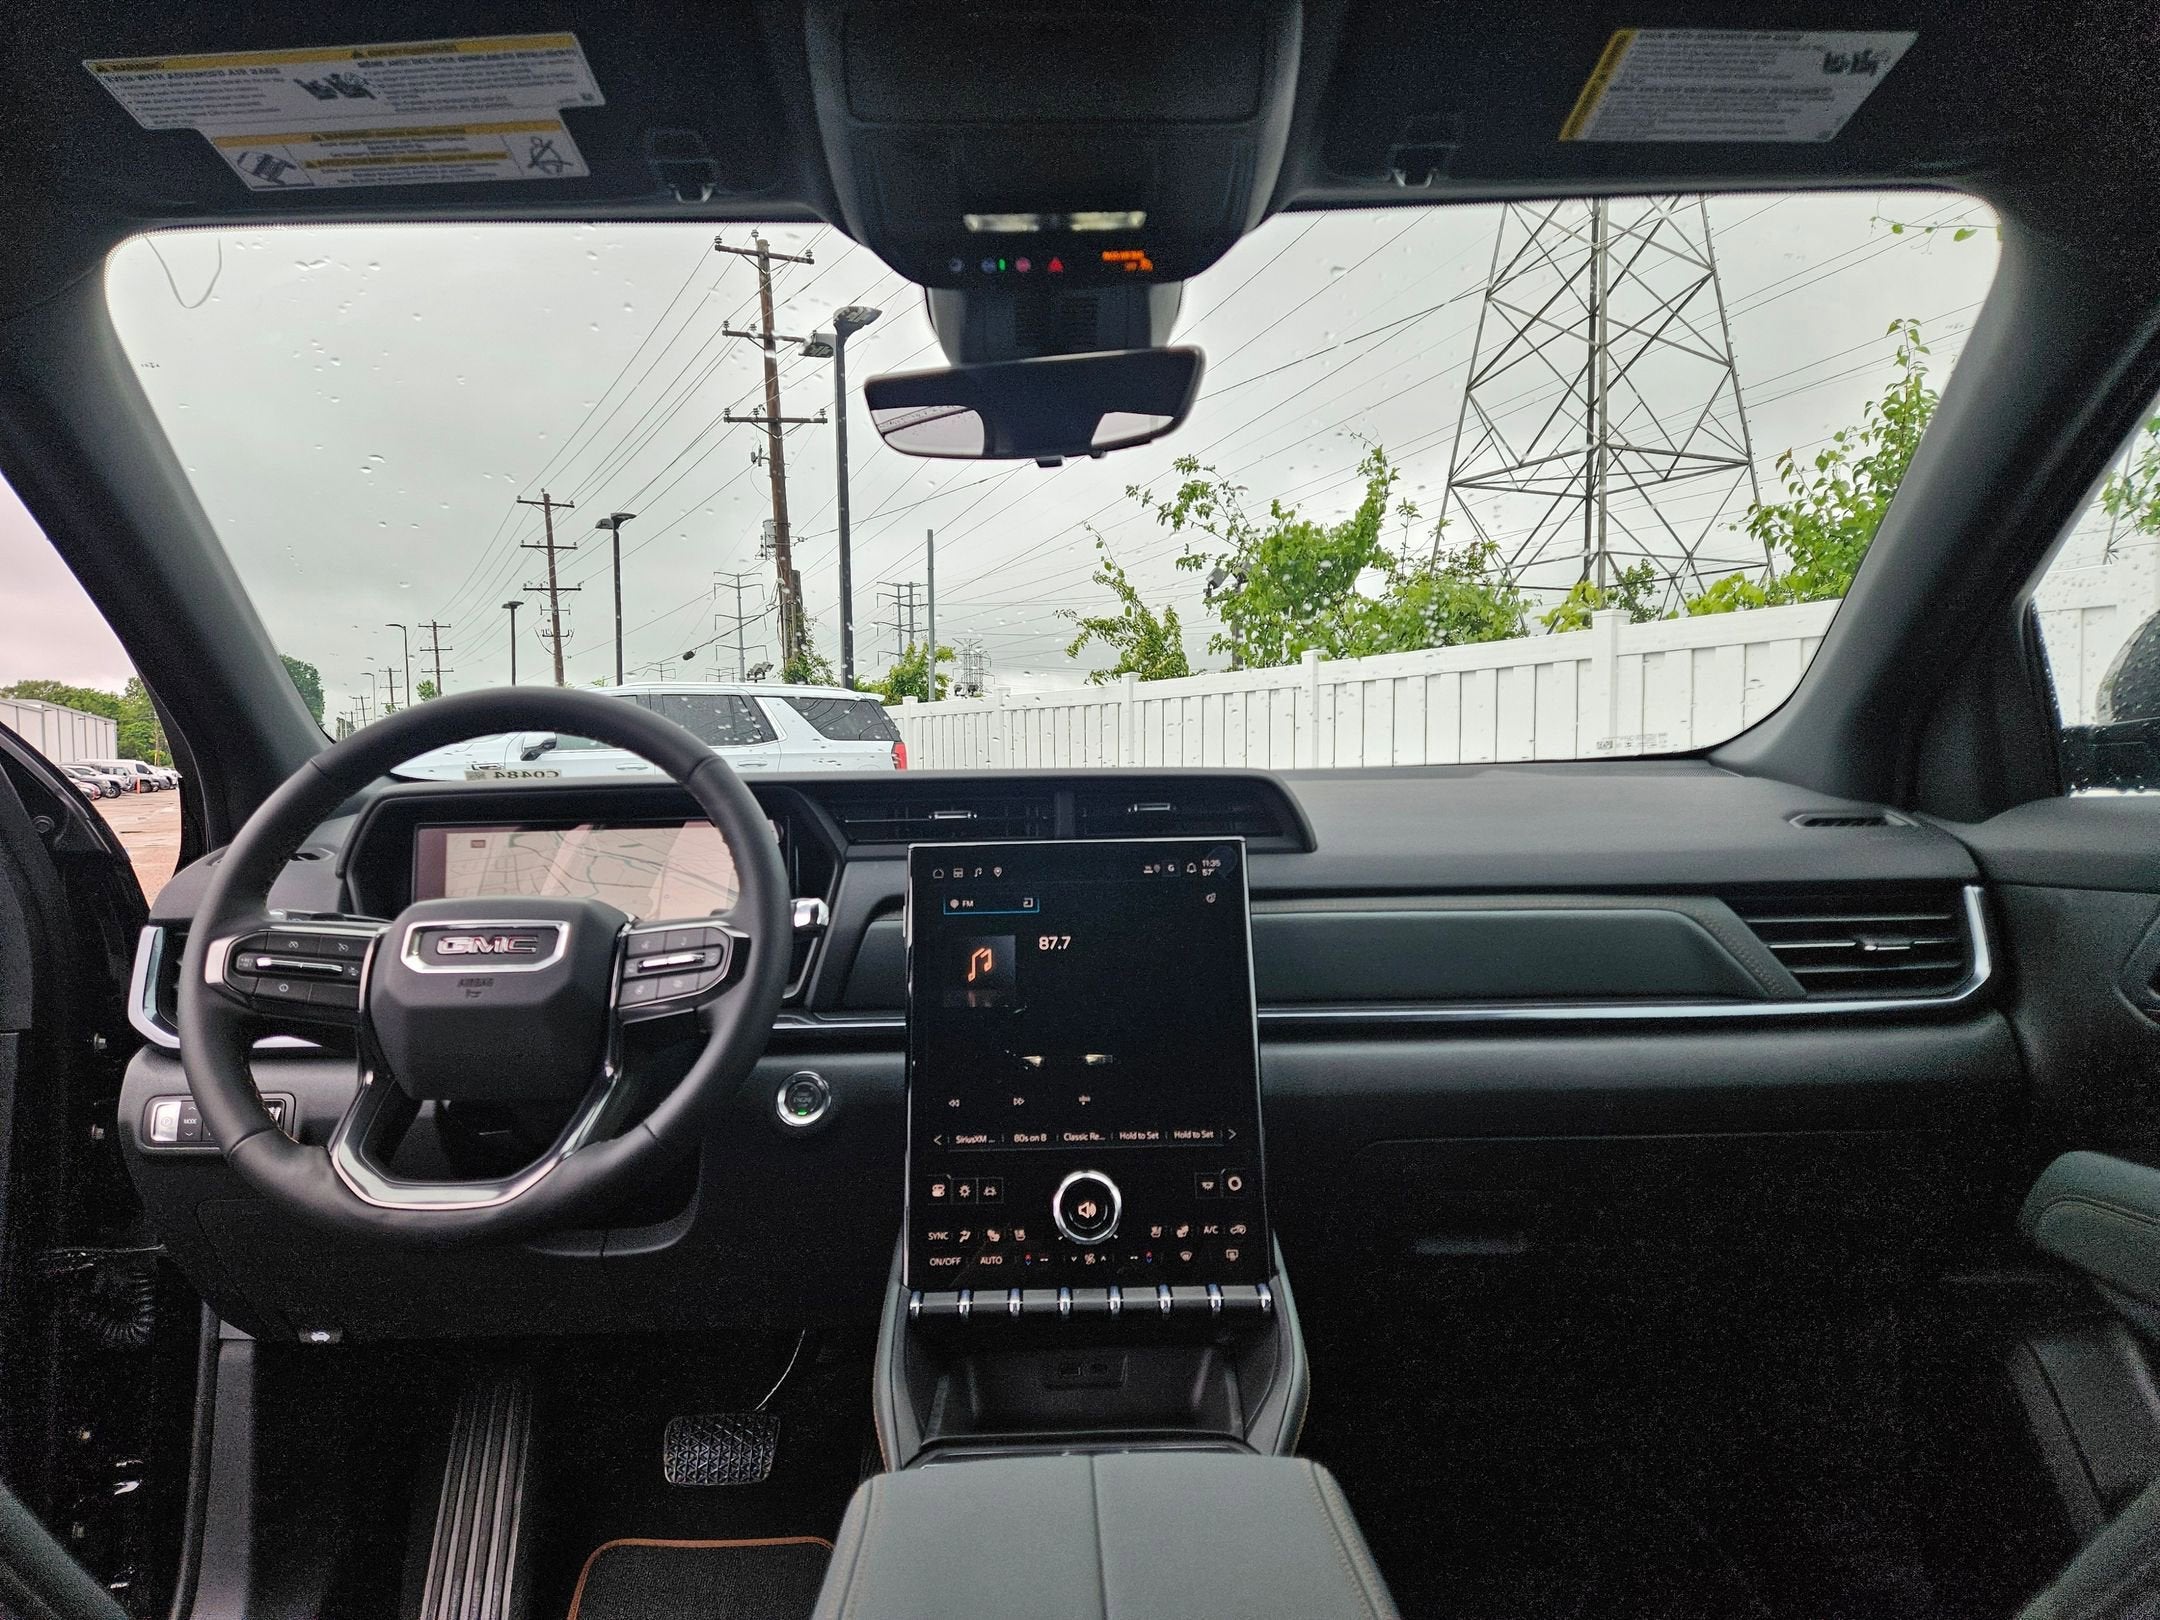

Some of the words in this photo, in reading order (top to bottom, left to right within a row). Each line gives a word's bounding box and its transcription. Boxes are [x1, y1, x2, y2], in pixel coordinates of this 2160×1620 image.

[436, 935, 539, 955] GMC
[1038, 936, 1071, 950] 87.7
[1063, 1132, 1088, 1142] Classic
[1119, 1131, 1137, 1140] Hold
[1138, 1132, 1145, 1140] to
[1146, 1131, 1160, 1140] Set
[1173, 1130, 1191, 1139] Hold
[1192, 1131, 1200, 1139] to
[1201, 1130, 1214, 1139] Set
[955, 1135, 987, 1144] SiriusXM
[1203, 1225, 1219, 1234] A/C
[928, 1232, 949, 1240] SYNC
[929, 1257, 962, 1266] ON/OFF
[980, 1256, 1003, 1265] AUTO
